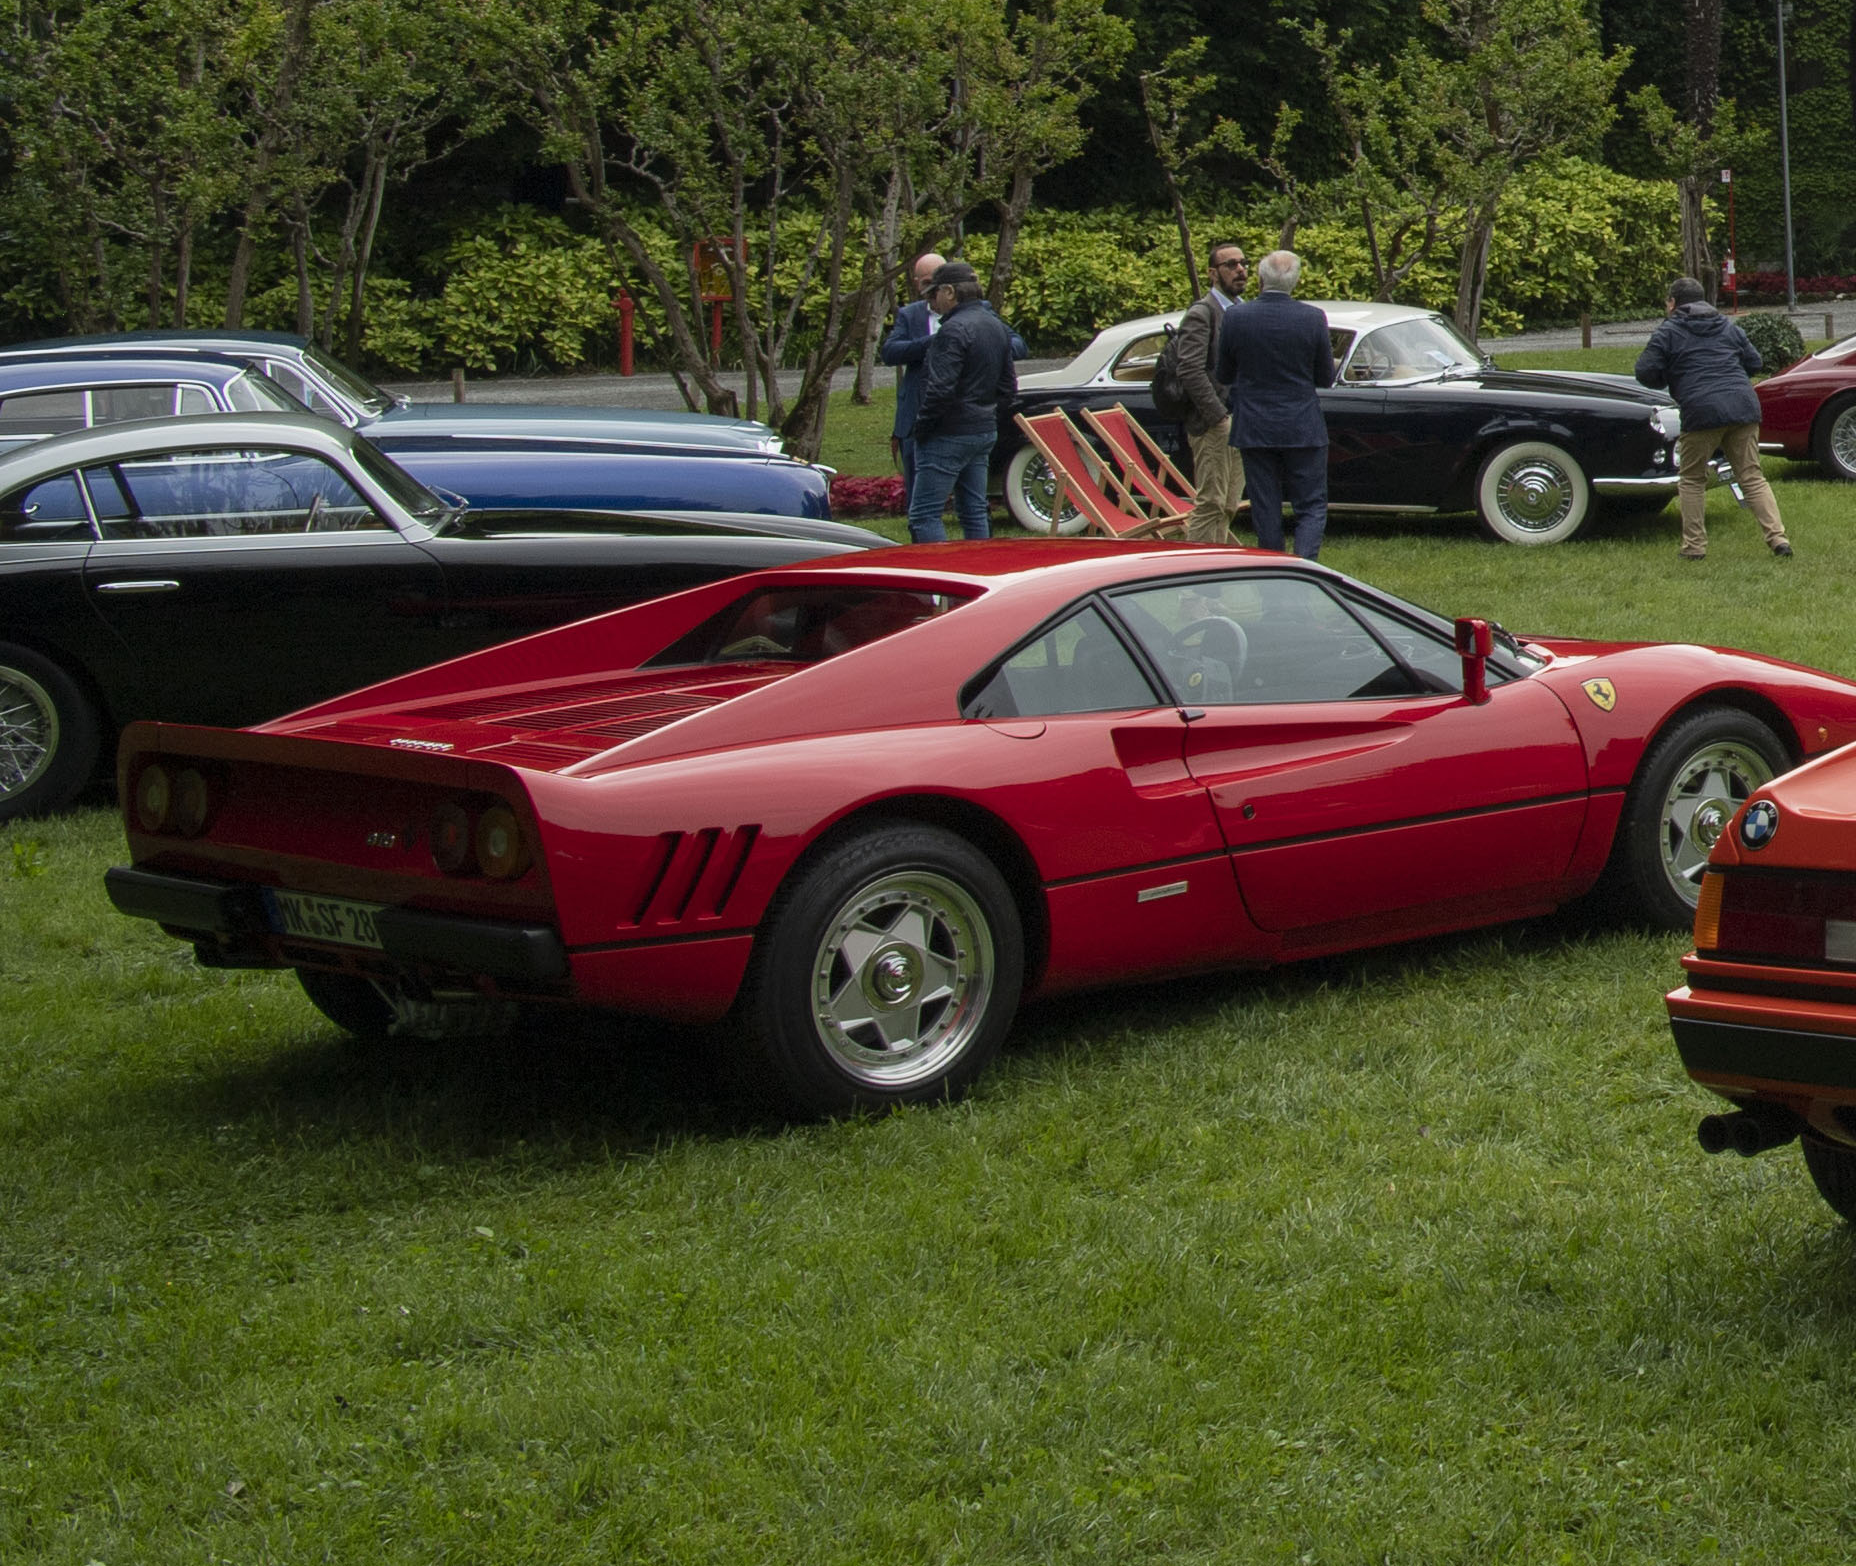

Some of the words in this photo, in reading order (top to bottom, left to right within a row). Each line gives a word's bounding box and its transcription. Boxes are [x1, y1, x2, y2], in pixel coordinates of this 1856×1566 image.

[277, 897, 310, 932] MK
[316, 902, 345, 938] SF
[345, 908, 378, 943] 28
